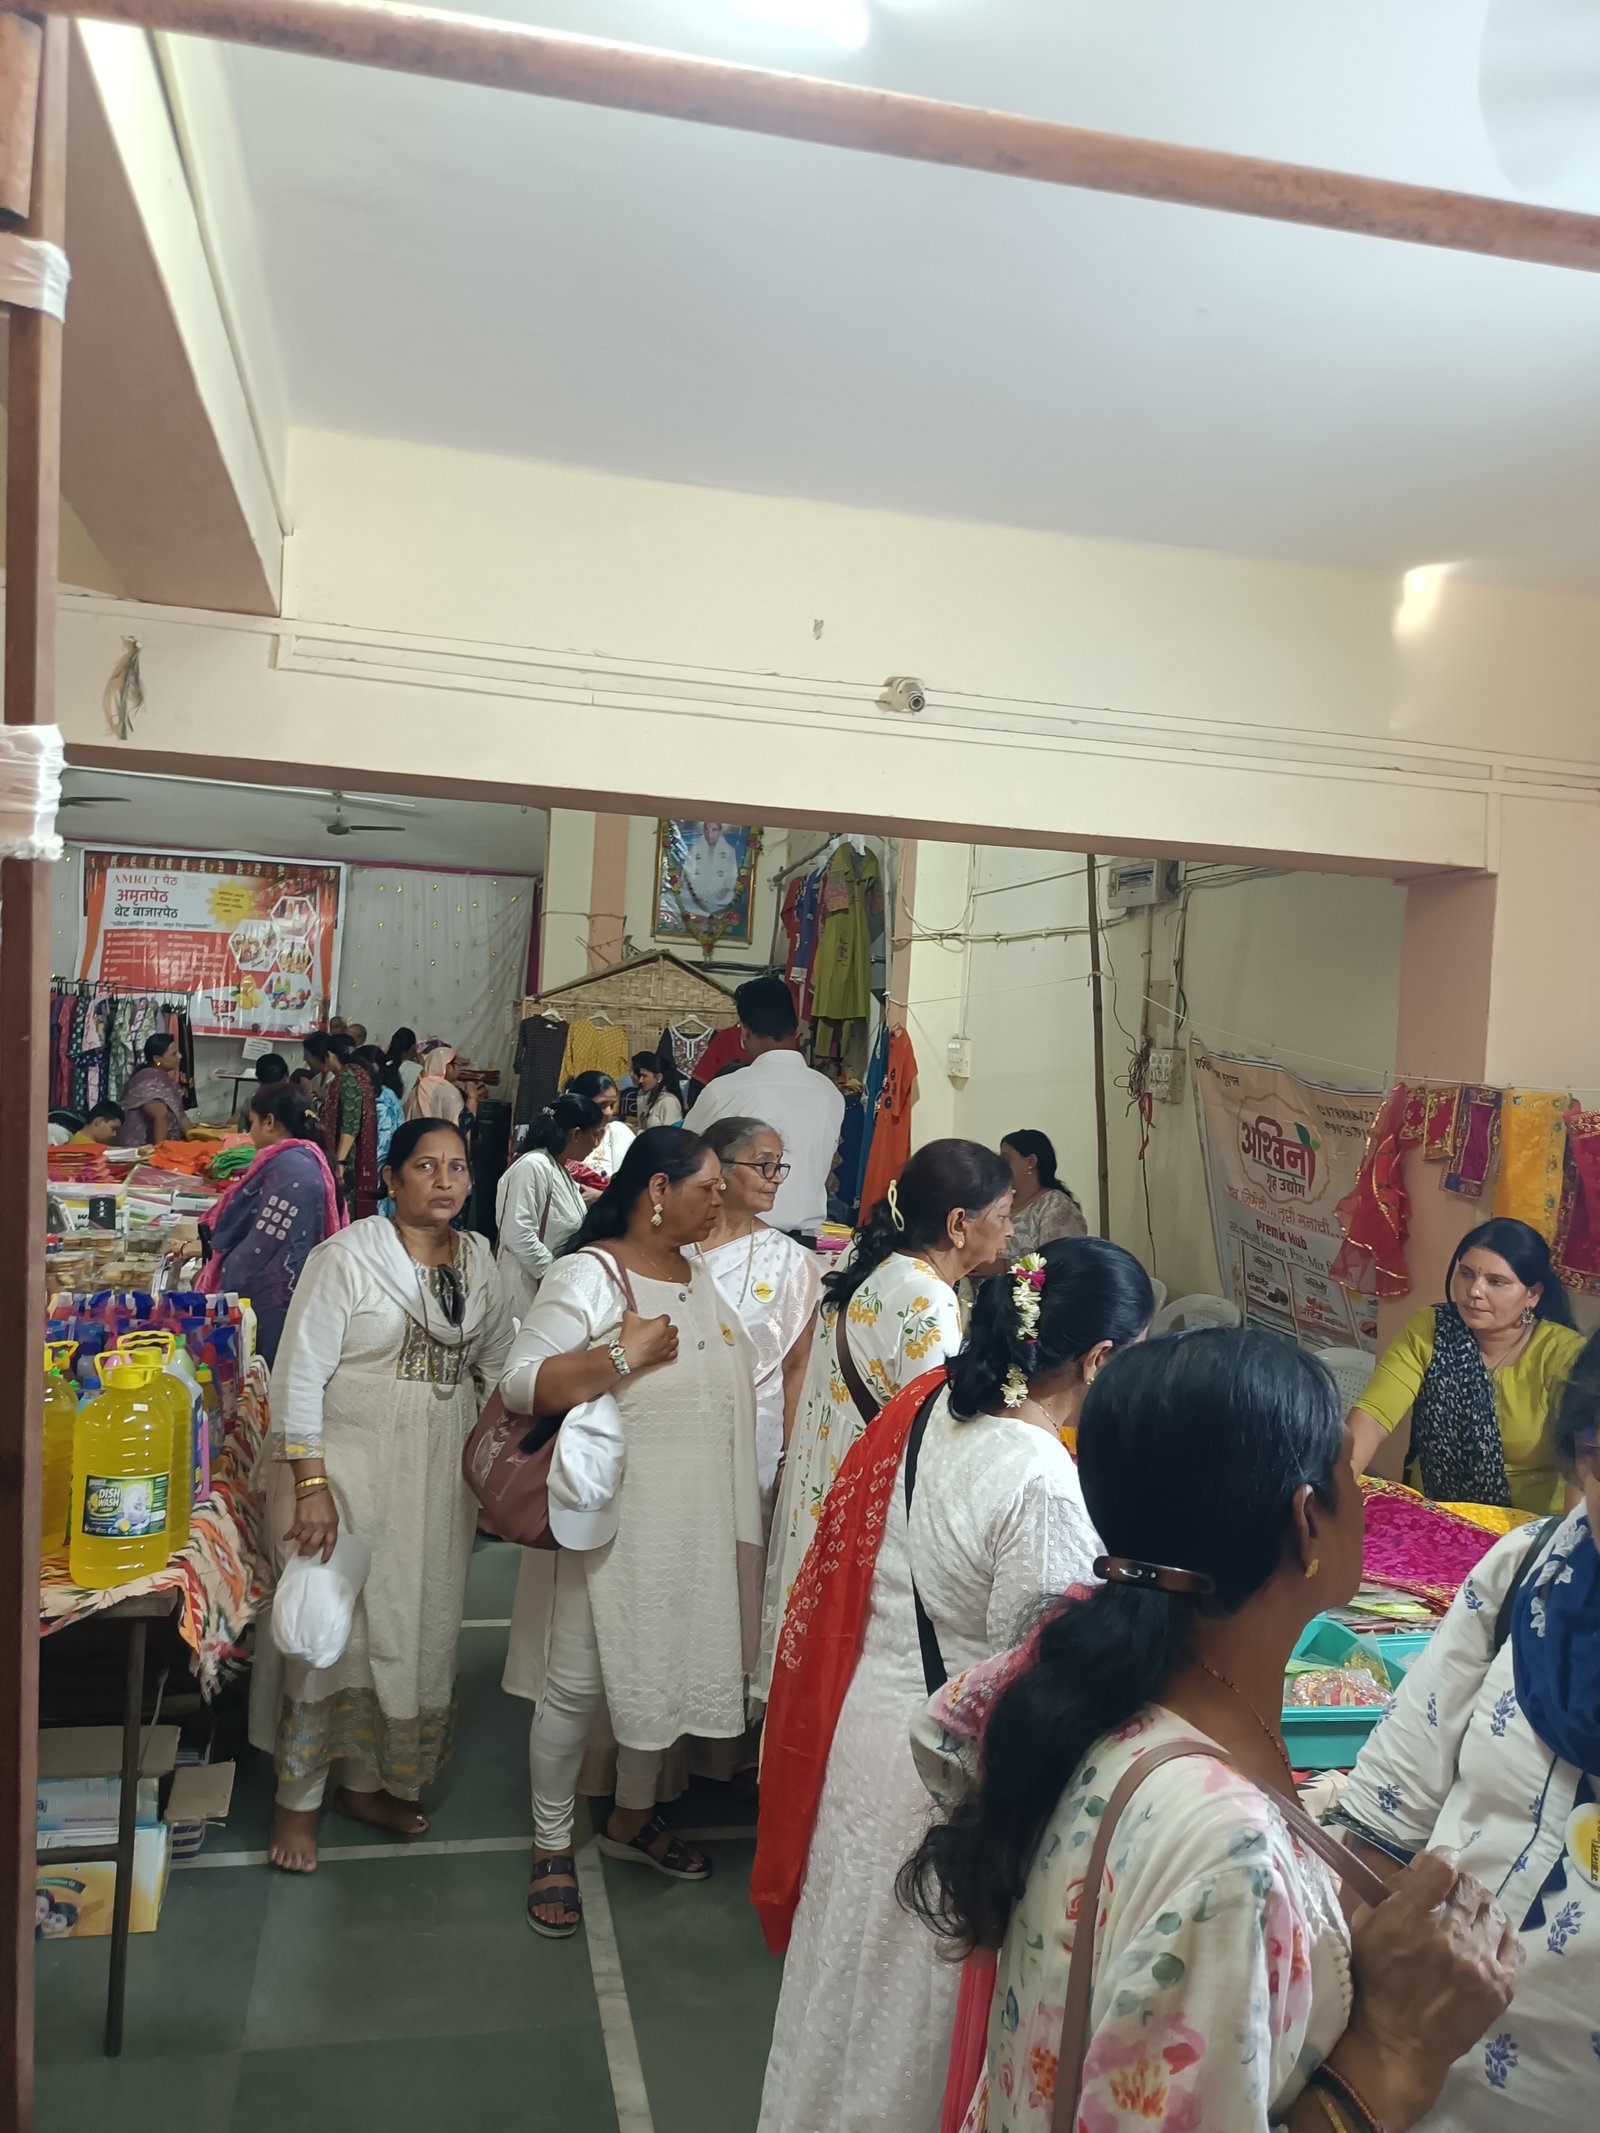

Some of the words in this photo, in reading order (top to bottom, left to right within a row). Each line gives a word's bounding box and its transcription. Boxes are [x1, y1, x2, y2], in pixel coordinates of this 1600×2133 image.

[112, 874, 159, 885] AMRUT
[117, 887, 169, 906] अमृतपेठ
[114, 904, 131, 917] थेट
[132, 905, 178, 919] बाजारपेठ
[1278, 1177, 1306, 1198] उद्योग
[99, 1488, 121, 1499] DISH
[98, 1499, 120, 1507] WASH
